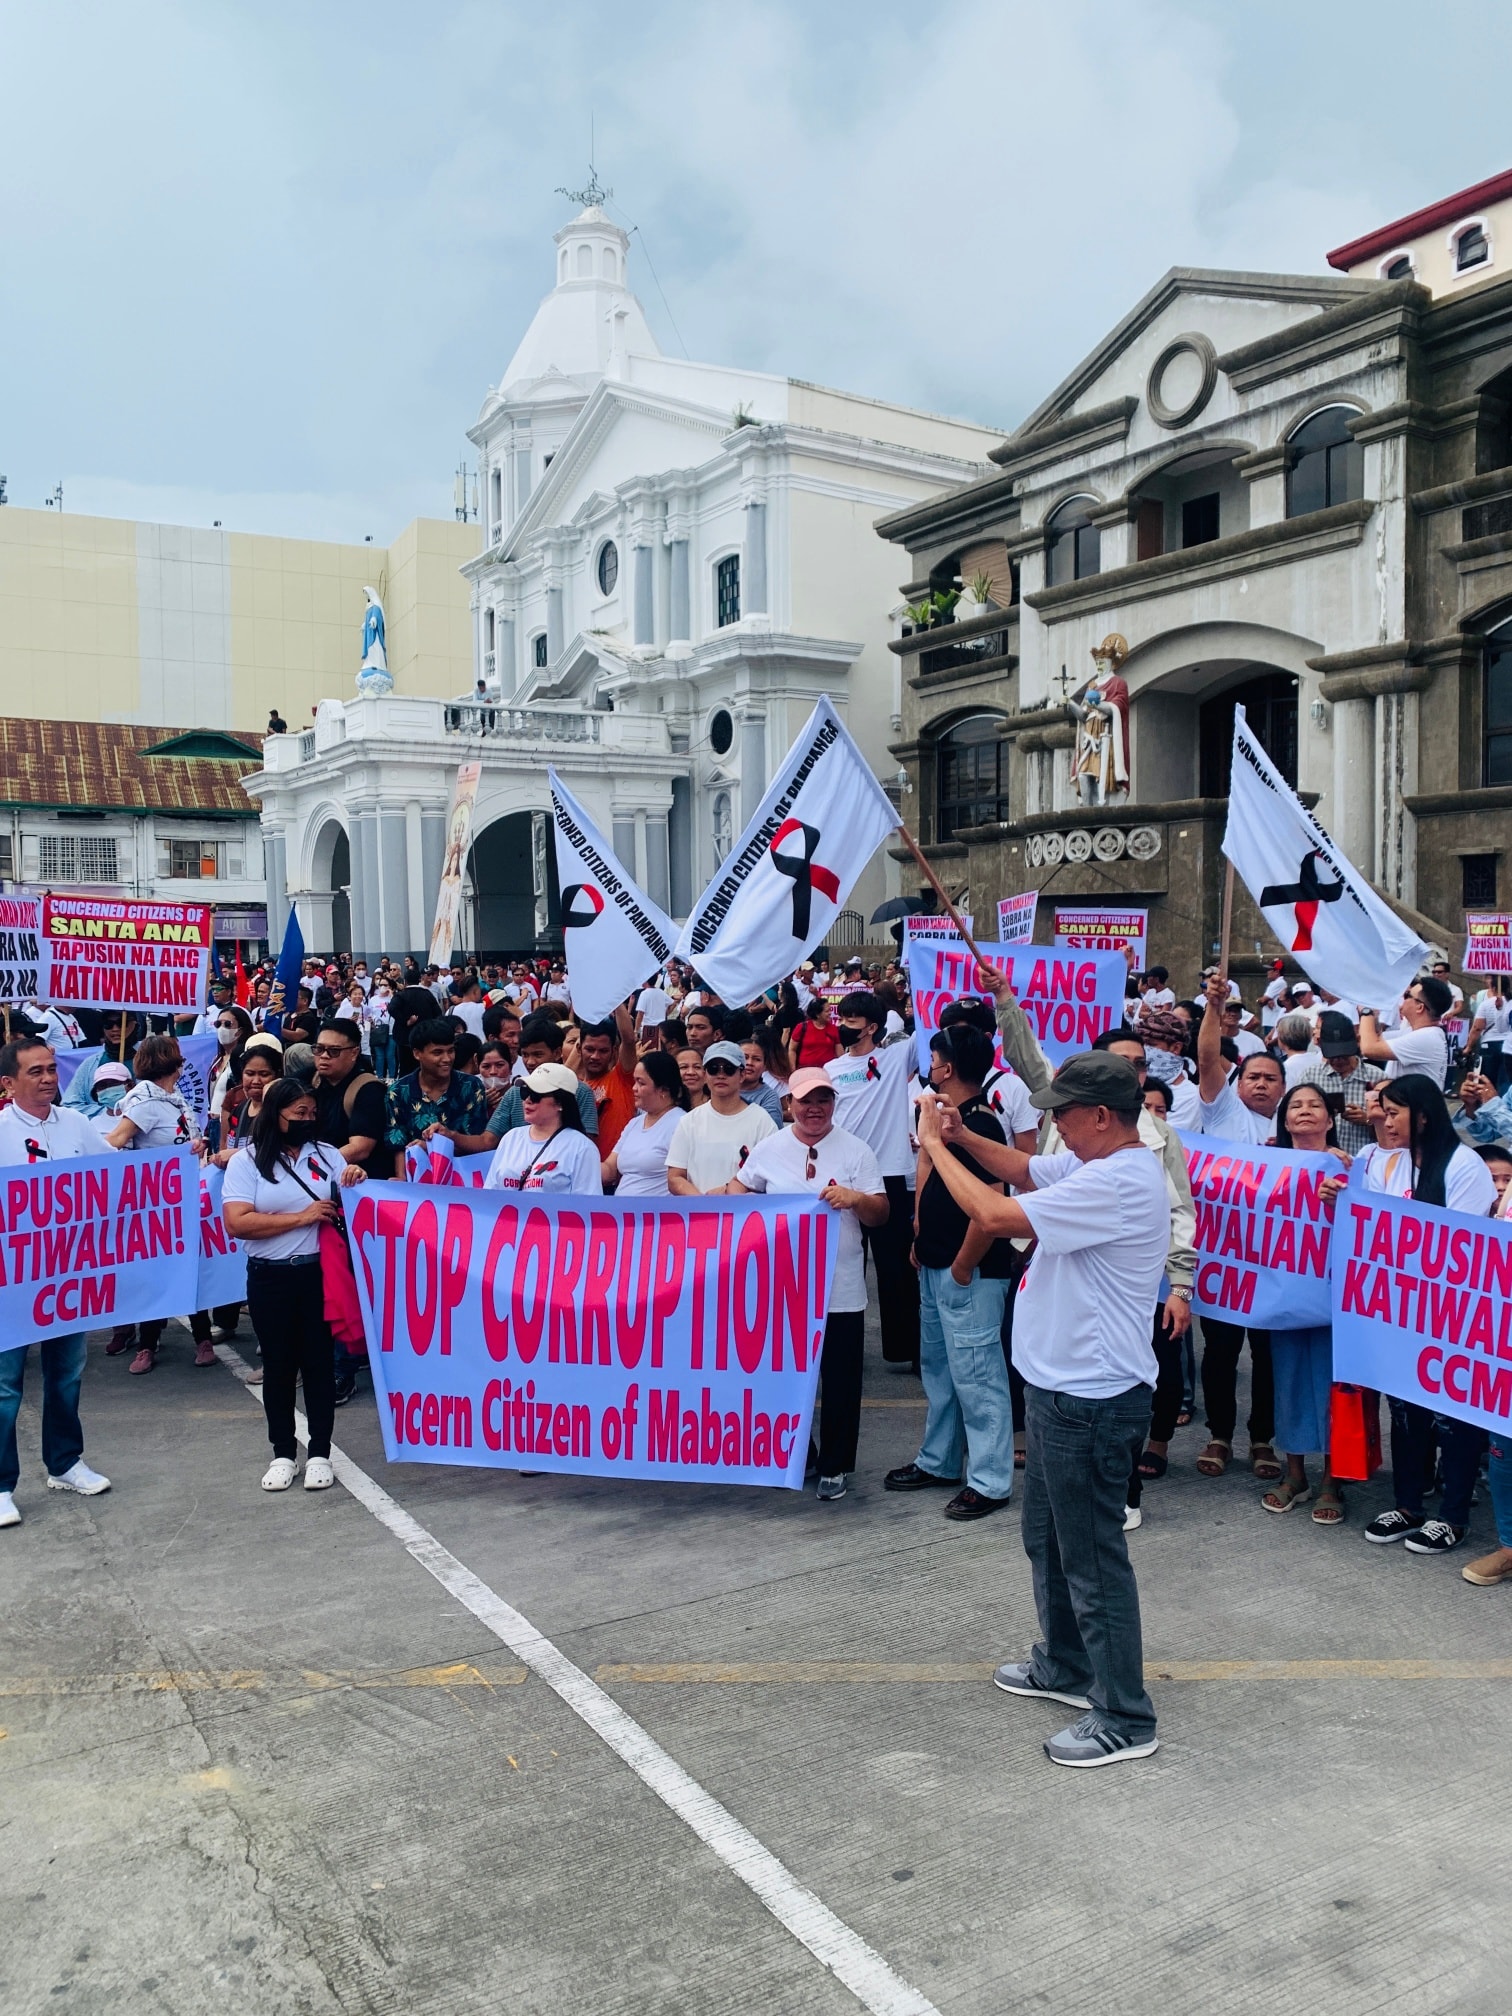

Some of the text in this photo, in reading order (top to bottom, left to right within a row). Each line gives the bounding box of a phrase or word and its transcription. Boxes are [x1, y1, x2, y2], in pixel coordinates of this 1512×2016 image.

[690, 876, 741, 955] ONCERNED
[732, 816, 782, 884] CITIZENS
[773, 796, 792, 820] OF
[50, 899, 203, 923] CONCERNED CITIZENS OF
[578, 845, 623, 895] CITIZENS
[614, 891, 635, 911] OF
[625, 903, 671, 965] PAMPANGA
[1001, 910, 1021, 928] SOBRA
[1059, 915, 1141, 924] CONCERNED CITIZENS OF
[18, 932, 39, 961] NA
[50, 916, 202, 944] SANTA ANA
[1059, 924, 1139, 936] SANTA ANA
[1470, 923, 1506, 935] SANTA
[50, 940, 199, 969] TAPUSIN NA ANG
[49, 963, 197, 1007] KATIWALIAN!
[1027, 959, 1097, 1003] ANG
[0, 1157, 183, 1233] PUSIN ANG
[1350, 1203, 1512, 1299] TAPUSIN
[33, 1273, 116, 1327] CCM
[352, 1196, 828, 1375] STOP CORRUPTION!
[1194, 1258, 1258, 1315] CM
[1417, 1345, 1512, 1418] CCM
[482, 1378, 591, 1458] Citizen
[601, 1383, 639, 1461] of
